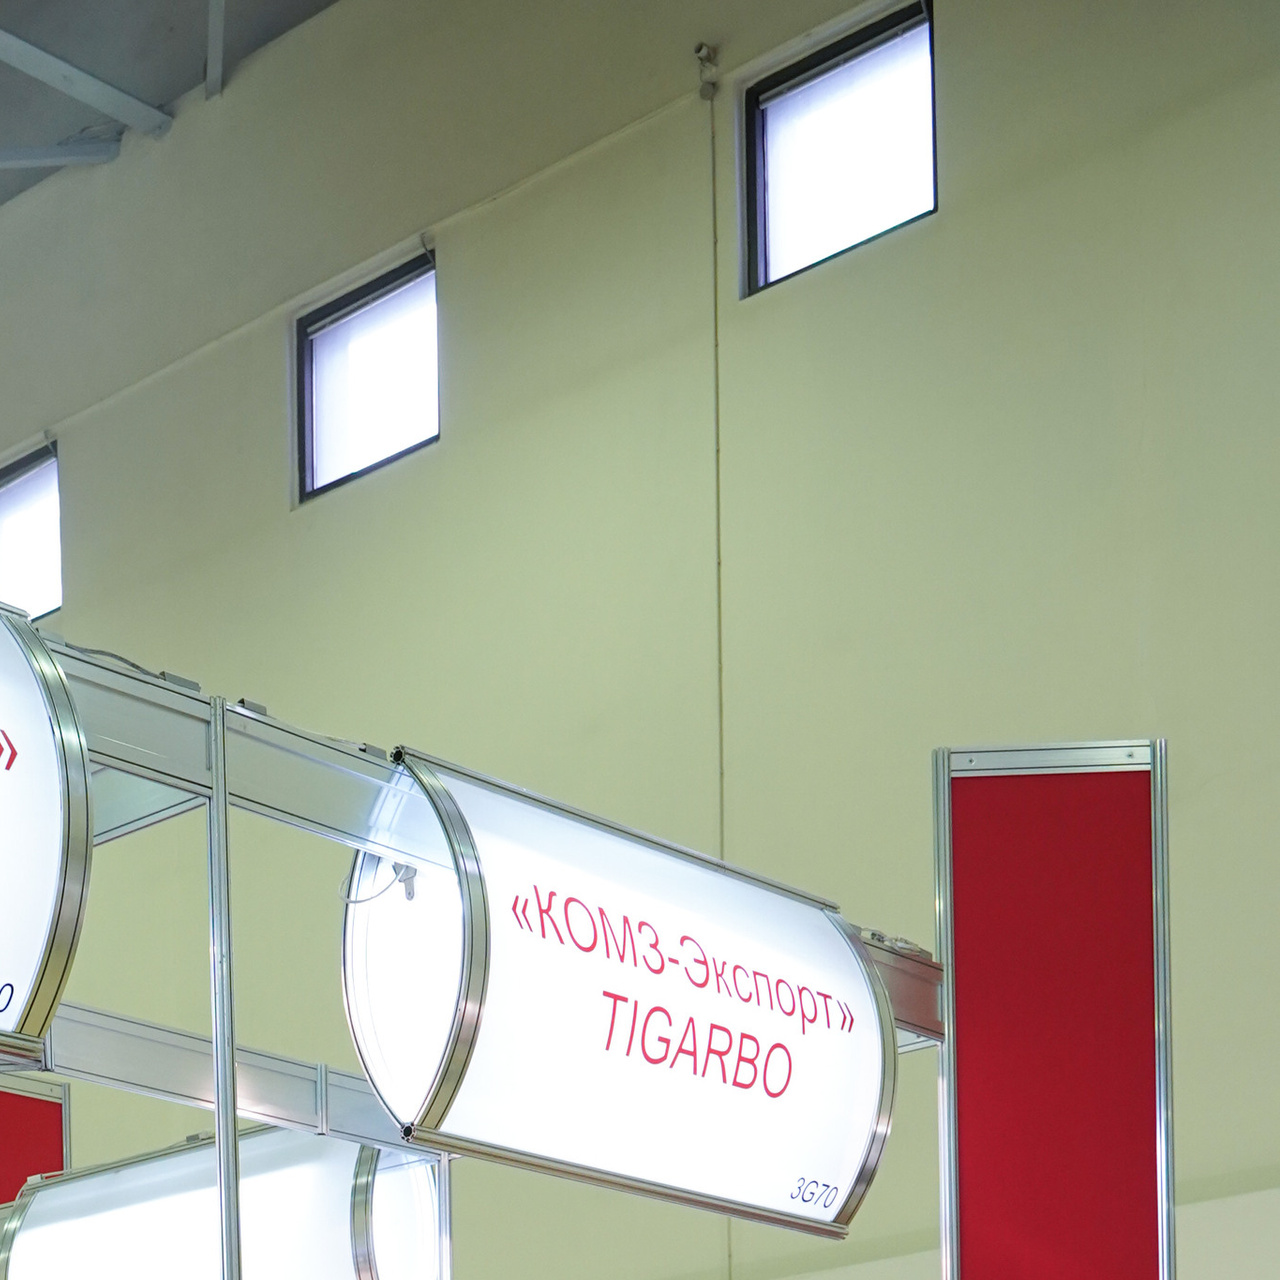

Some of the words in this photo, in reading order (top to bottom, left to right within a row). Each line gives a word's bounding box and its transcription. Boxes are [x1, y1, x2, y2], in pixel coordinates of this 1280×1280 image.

[511, 884, 855, 1035] «КОМЗ-Экспорт»
[602, 990, 793, 1099] TIGARBO
[790, 1177, 839, 1209] 3G70
